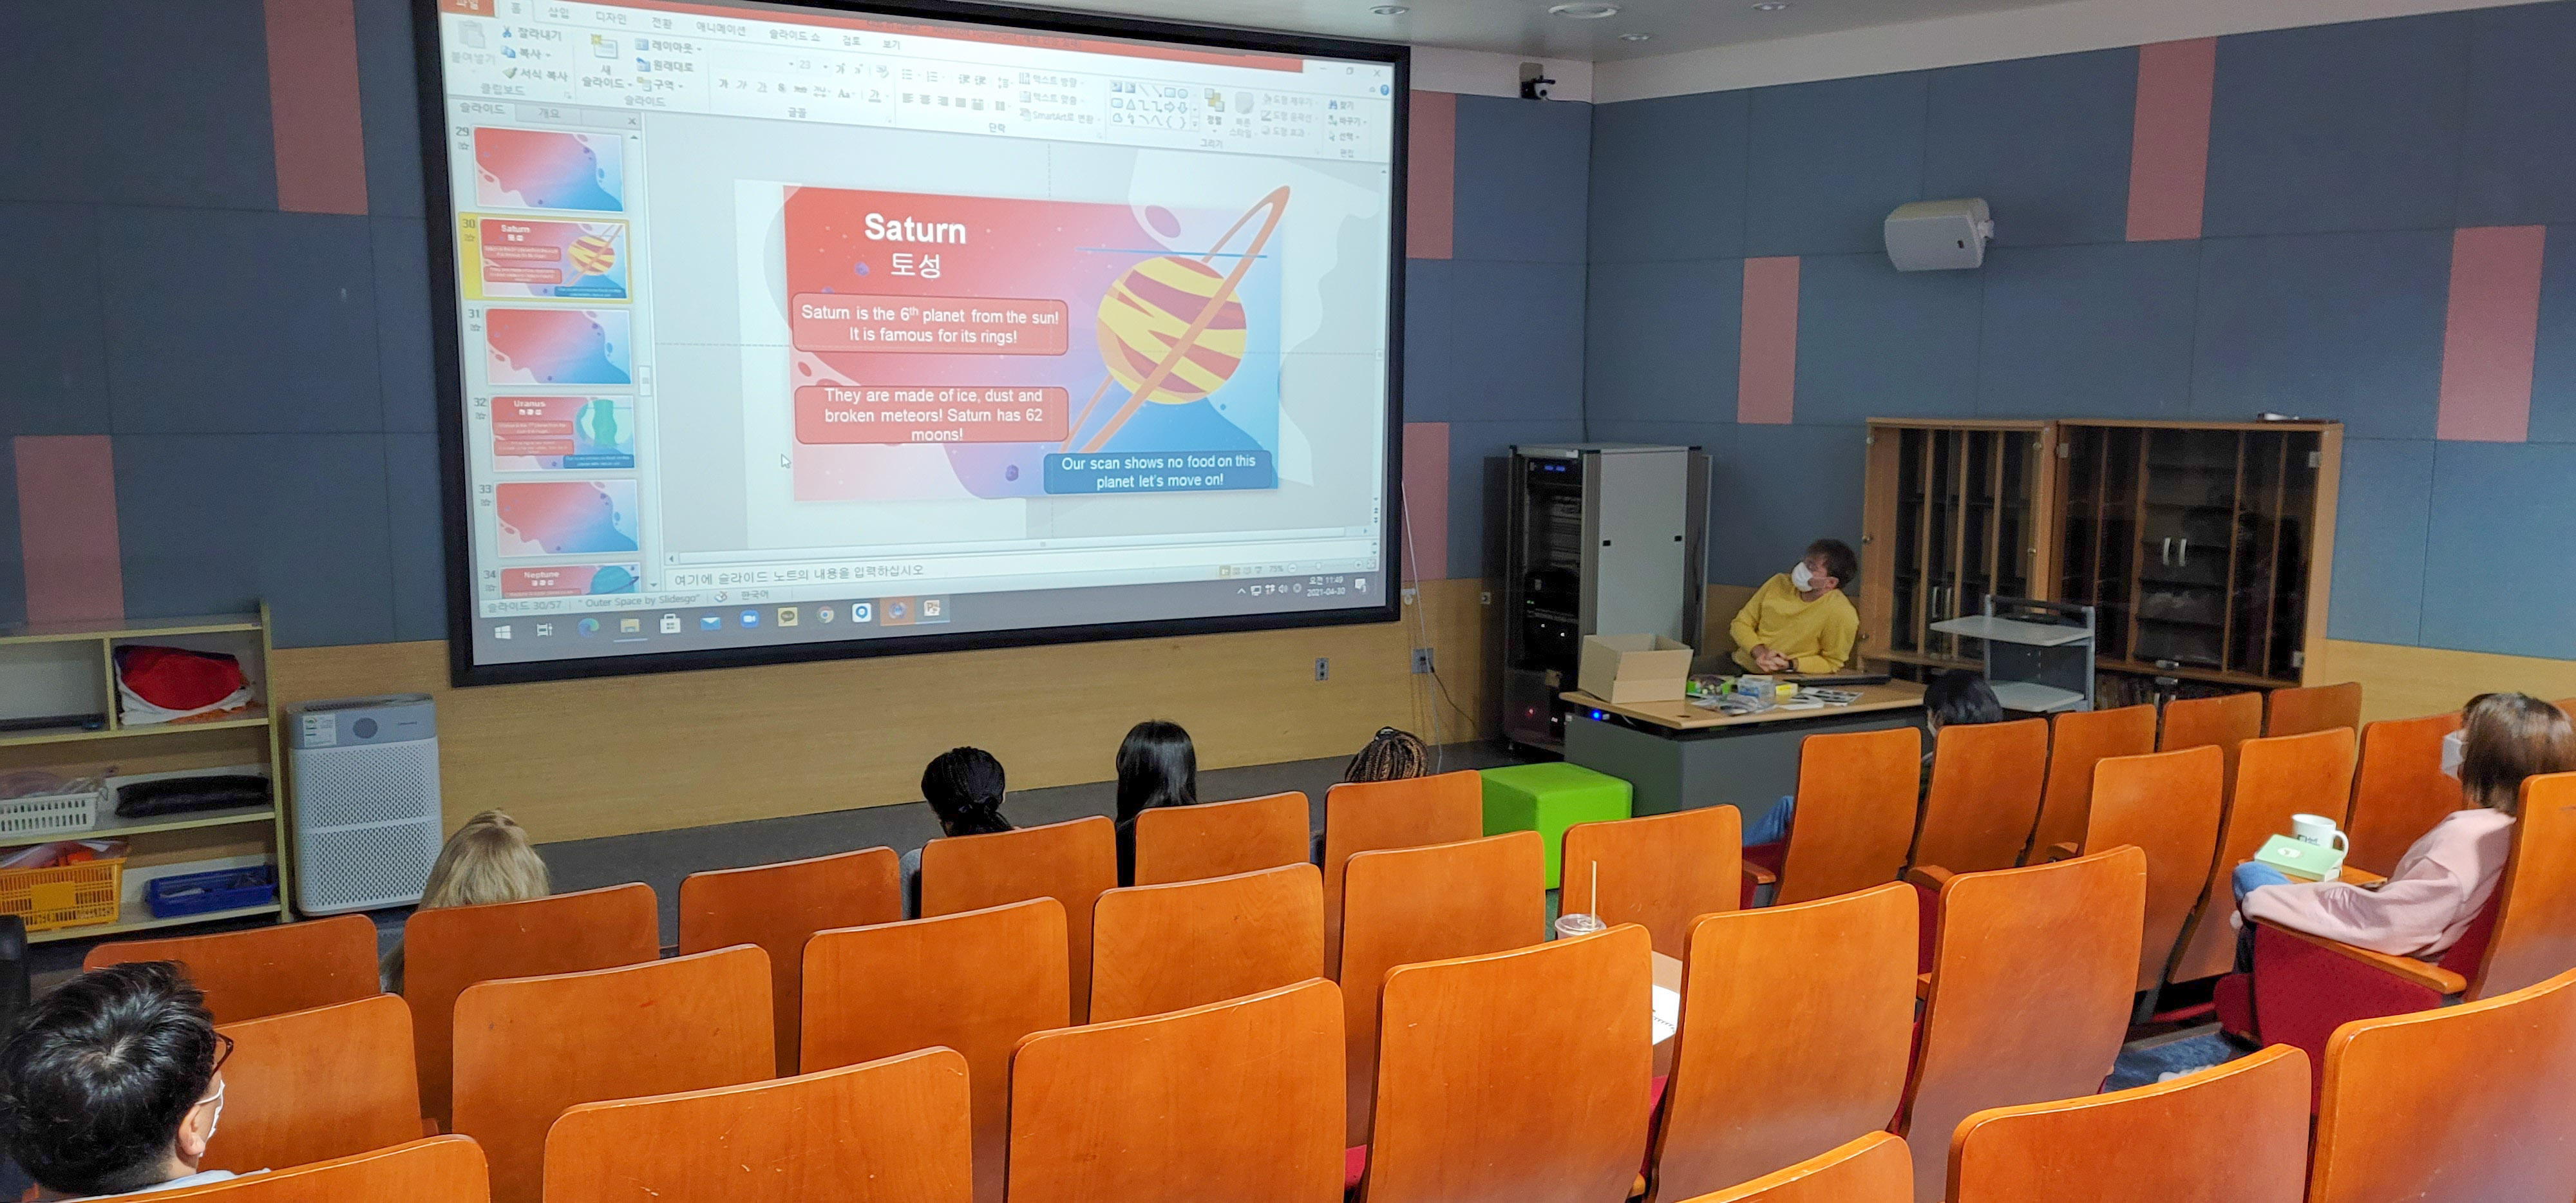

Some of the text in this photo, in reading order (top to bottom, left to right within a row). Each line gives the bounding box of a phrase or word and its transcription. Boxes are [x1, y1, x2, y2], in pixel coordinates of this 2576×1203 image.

[548, 6, 569, 19] 삽입
[596, 11, 627, 25] 디자인
[652, 17, 673, 30] 전환
[696, 21, 746, 36] 애니메이션
[518, 26, 562, 41] 잘라내기
[769, 29, 820, 42] 슬라이드 쇼
[652, 40, 693, 54] 레이아웃
[842, 35, 861, 46] 검토
[882, 40, 900, 51] 보기
[520, 48, 542, 60] 복사
[601, 64, 612, 75] 새
[654, 60, 694, 72] 원래대로
[520, 68, 568, 82] 서식 복사
[1033, 74, 1058, 85] 텍스트
[480, 82, 526, 96] 클립보드
[582, 76, 625, 89] 슬라이드
[654, 79, 674, 91] 구역
[624, 95, 666, 107] 슬라이드
[1033, 92, 1059, 103] 텍스트
[459, 102, 505, 114] 슬라이드
[538, 108, 561, 118] 개요
[456, 126, 469, 137] 29
[462, 219, 475, 229] 30
[864, 213, 966, 245] Saturn
[890, 252, 941, 279] 토성
[468, 310, 480, 319] 31
[801, 304, 1059, 325] Saturn is the 6th planet from the sun!
[849, 327, 1018, 346] It is famous for its rings!
[473, 397, 487, 407] 32
[824, 388, 1043, 405] They are made of ice, dust and
[824, 408, 1043, 422] broken meteors! Saturn has 62
[911, 428, 963, 441] moons!
[1061, 454, 1256, 470] Our scan shows no food on this
[1097, 475, 1134, 490] planet
[1168, 475, 1201, 487] move
[1204, 473, 1224, 486] on!
[478, 484, 491, 494] 33
[484, 569, 497, 579] 34
[524, 571, 560, 580] Neptune
[675, 564, 924, 586] 여기에 슬라이드 노트의 내용을 입력하십시오
[614, 596, 641, 607] Space
[645, 594, 655, 605] by
[741, 591, 769, 600] 한국어
[488, 600, 562, 614] 슬라이드 30/57
